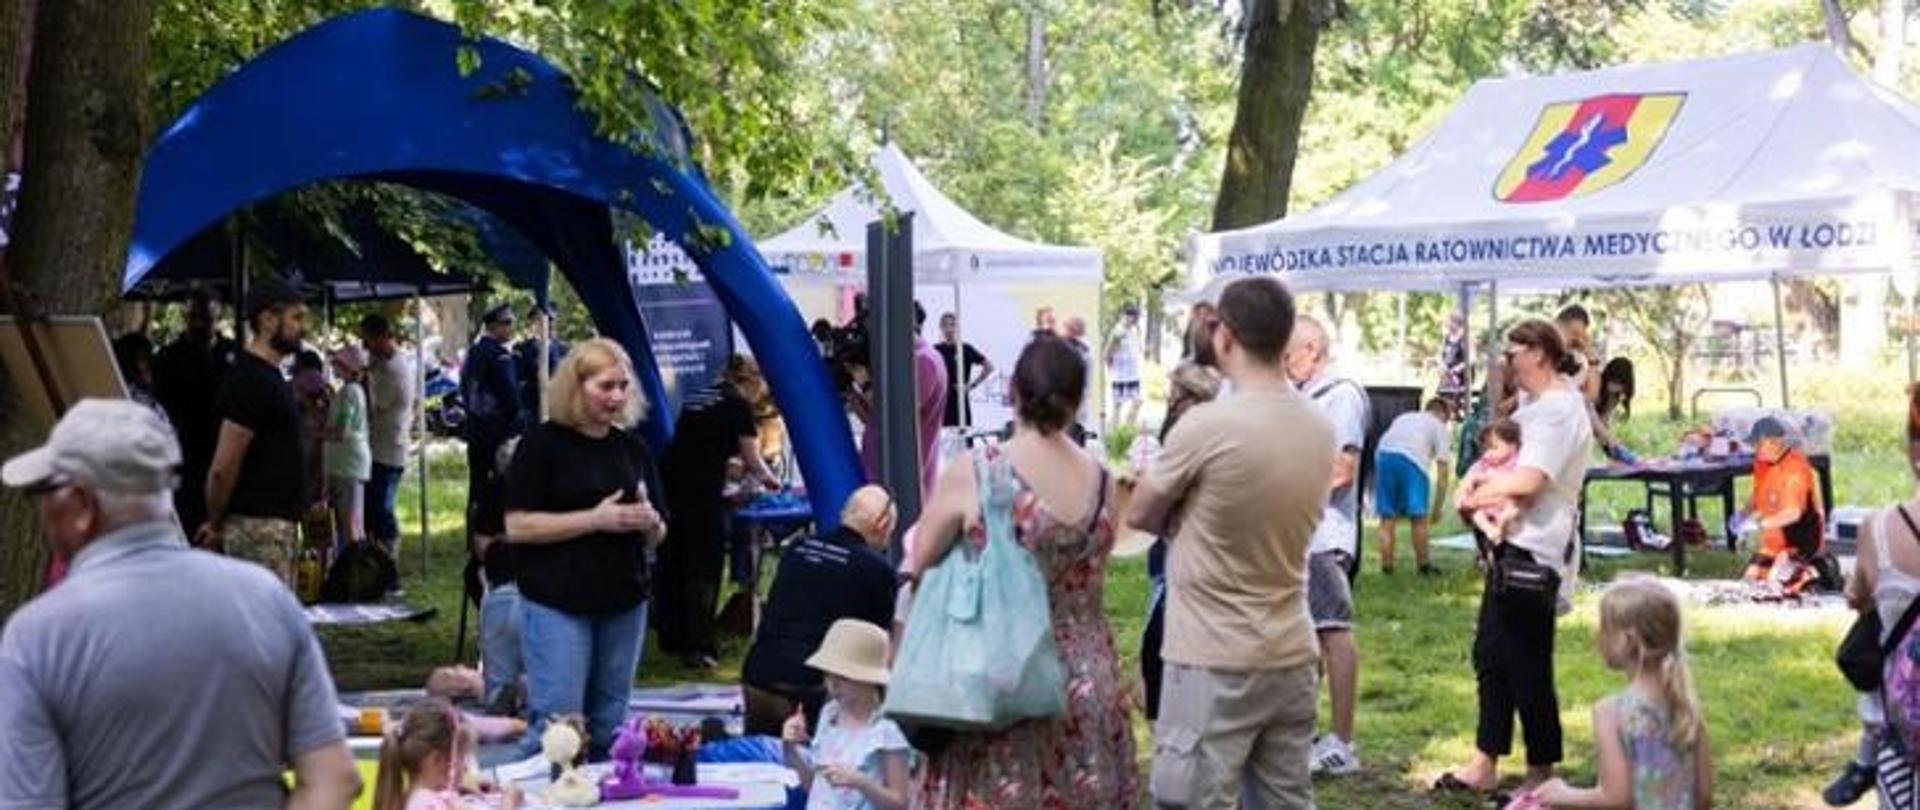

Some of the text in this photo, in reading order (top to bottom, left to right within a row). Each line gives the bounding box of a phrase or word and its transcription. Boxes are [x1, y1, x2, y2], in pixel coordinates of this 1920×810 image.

[1338, 242, 1408, 267] STACJA
[1415, 236, 1576, 263] RATOWNICTWA
[1768, 224, 1795, 249] W
[1800, 222, 1876, 248] ŁODZI
